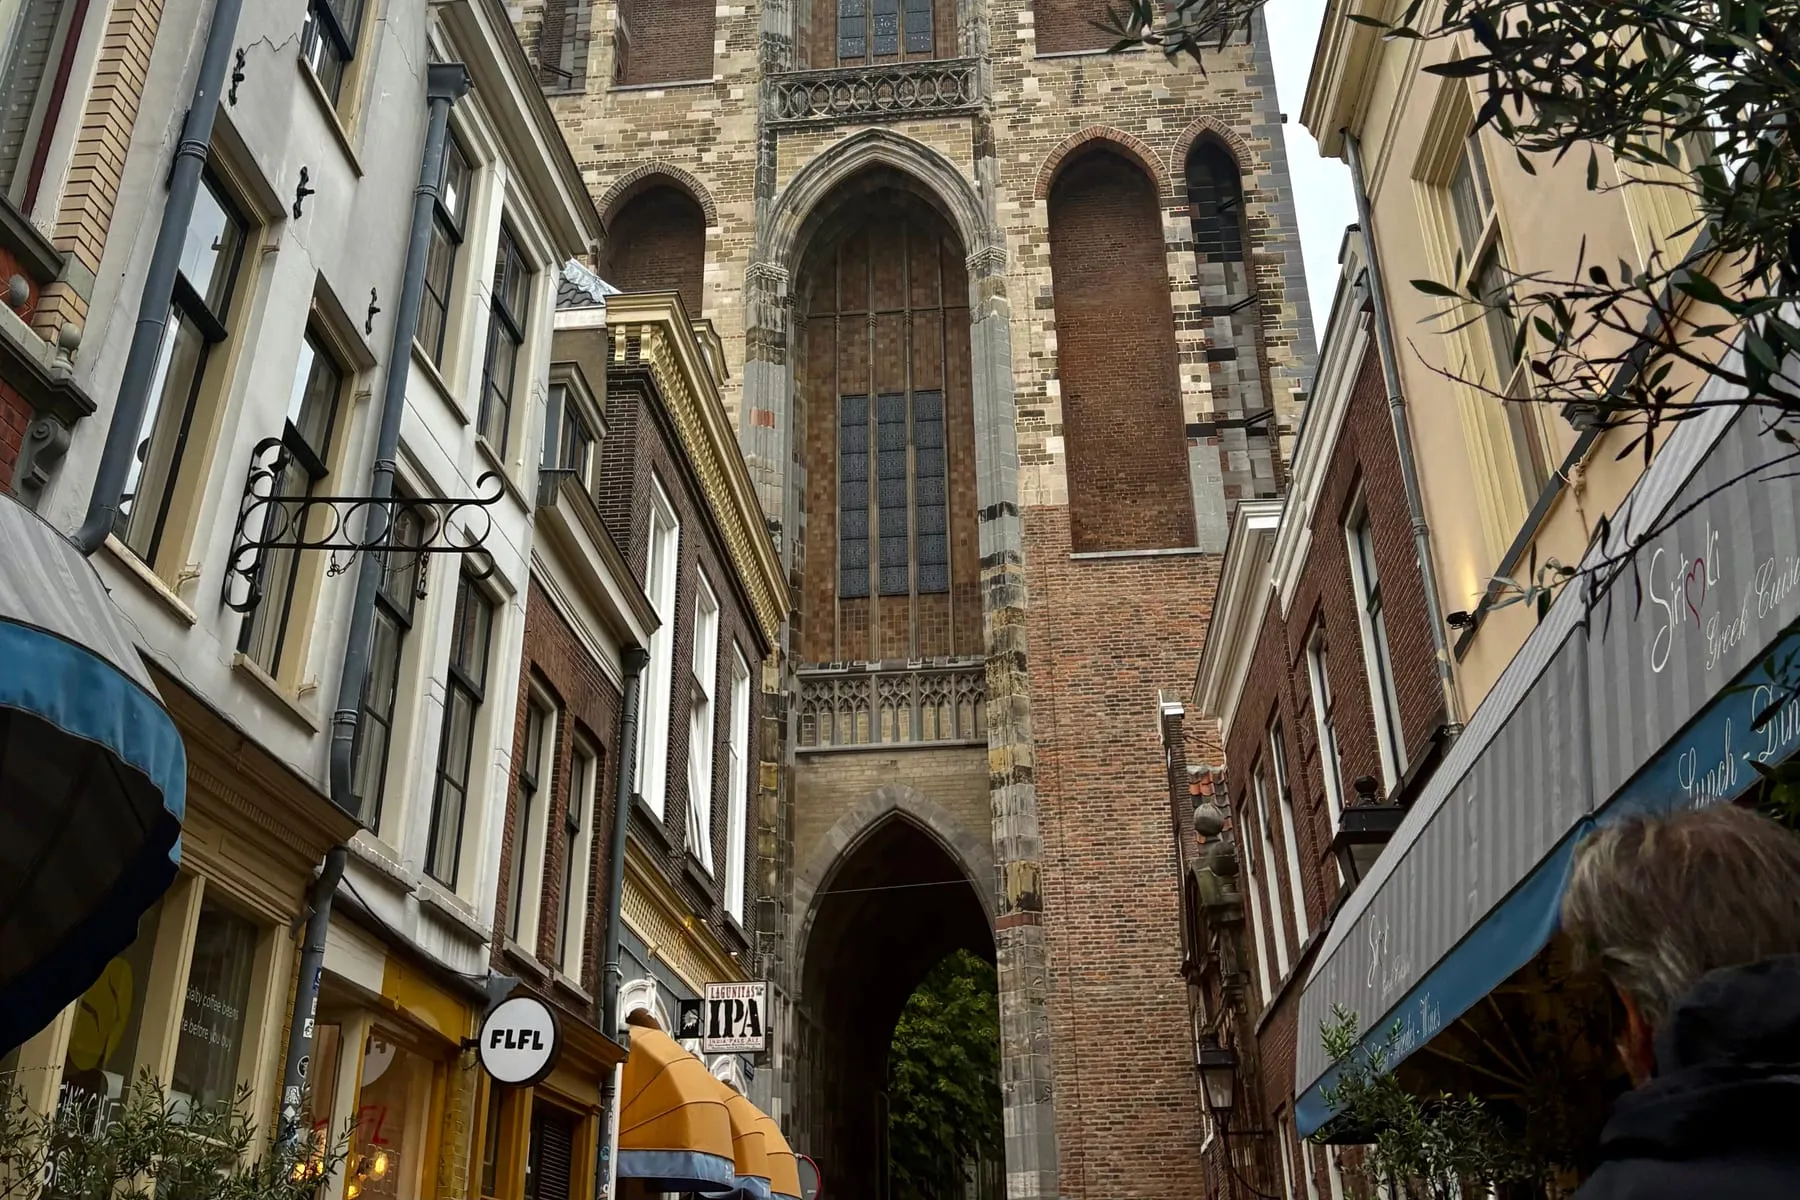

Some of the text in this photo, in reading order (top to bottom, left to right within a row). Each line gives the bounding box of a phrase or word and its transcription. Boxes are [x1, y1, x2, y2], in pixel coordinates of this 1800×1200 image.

[711, 986, 755, 999] LAGUNITAS
[708, 998, 763, 1039] IPA
[490, 1029, 544, 1050] FLFL
